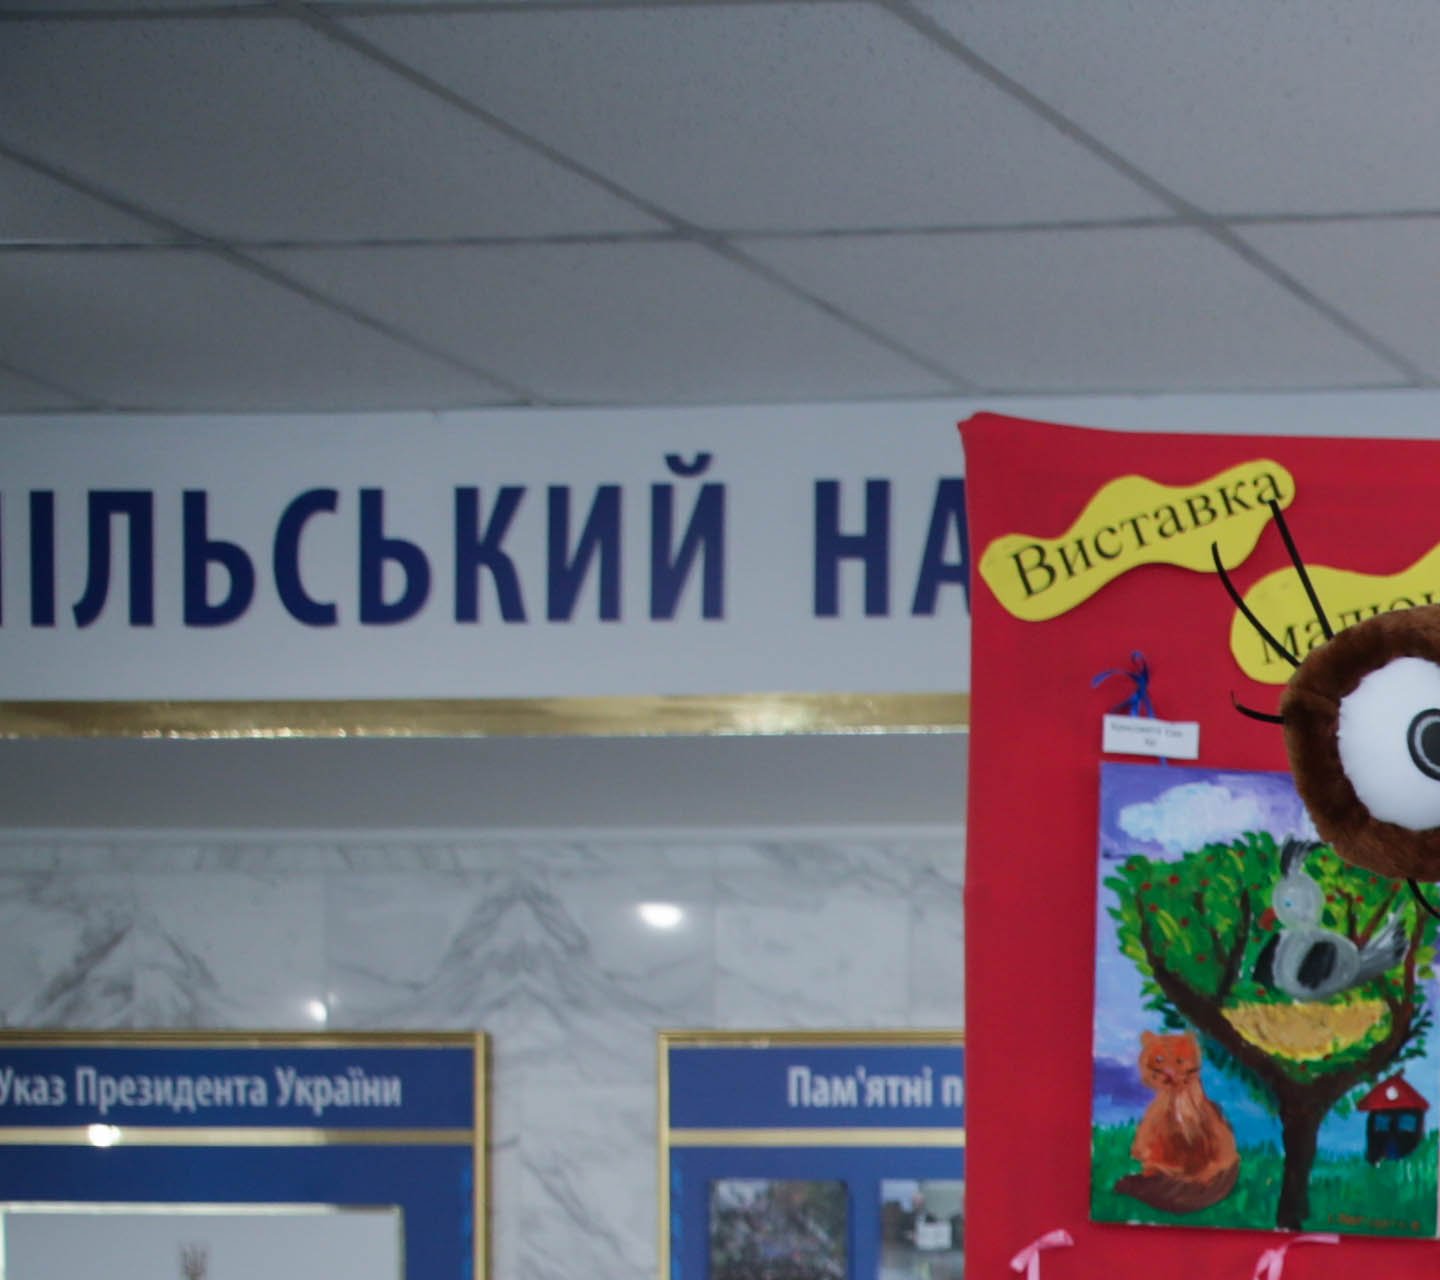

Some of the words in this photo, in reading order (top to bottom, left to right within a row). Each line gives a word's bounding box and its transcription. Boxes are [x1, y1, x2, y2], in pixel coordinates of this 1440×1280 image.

[0, 452, 727, 630] ІЛЬСЬКИЙ
[1011, 469, 1286, 602] Виставка
[0, 1066, 66, 1107] Указ
[76, 1065, 268, 1114] Президента
[274, 1066, 402, 1117] України
[787, 1064, 933, 1109] Пам'ятні
